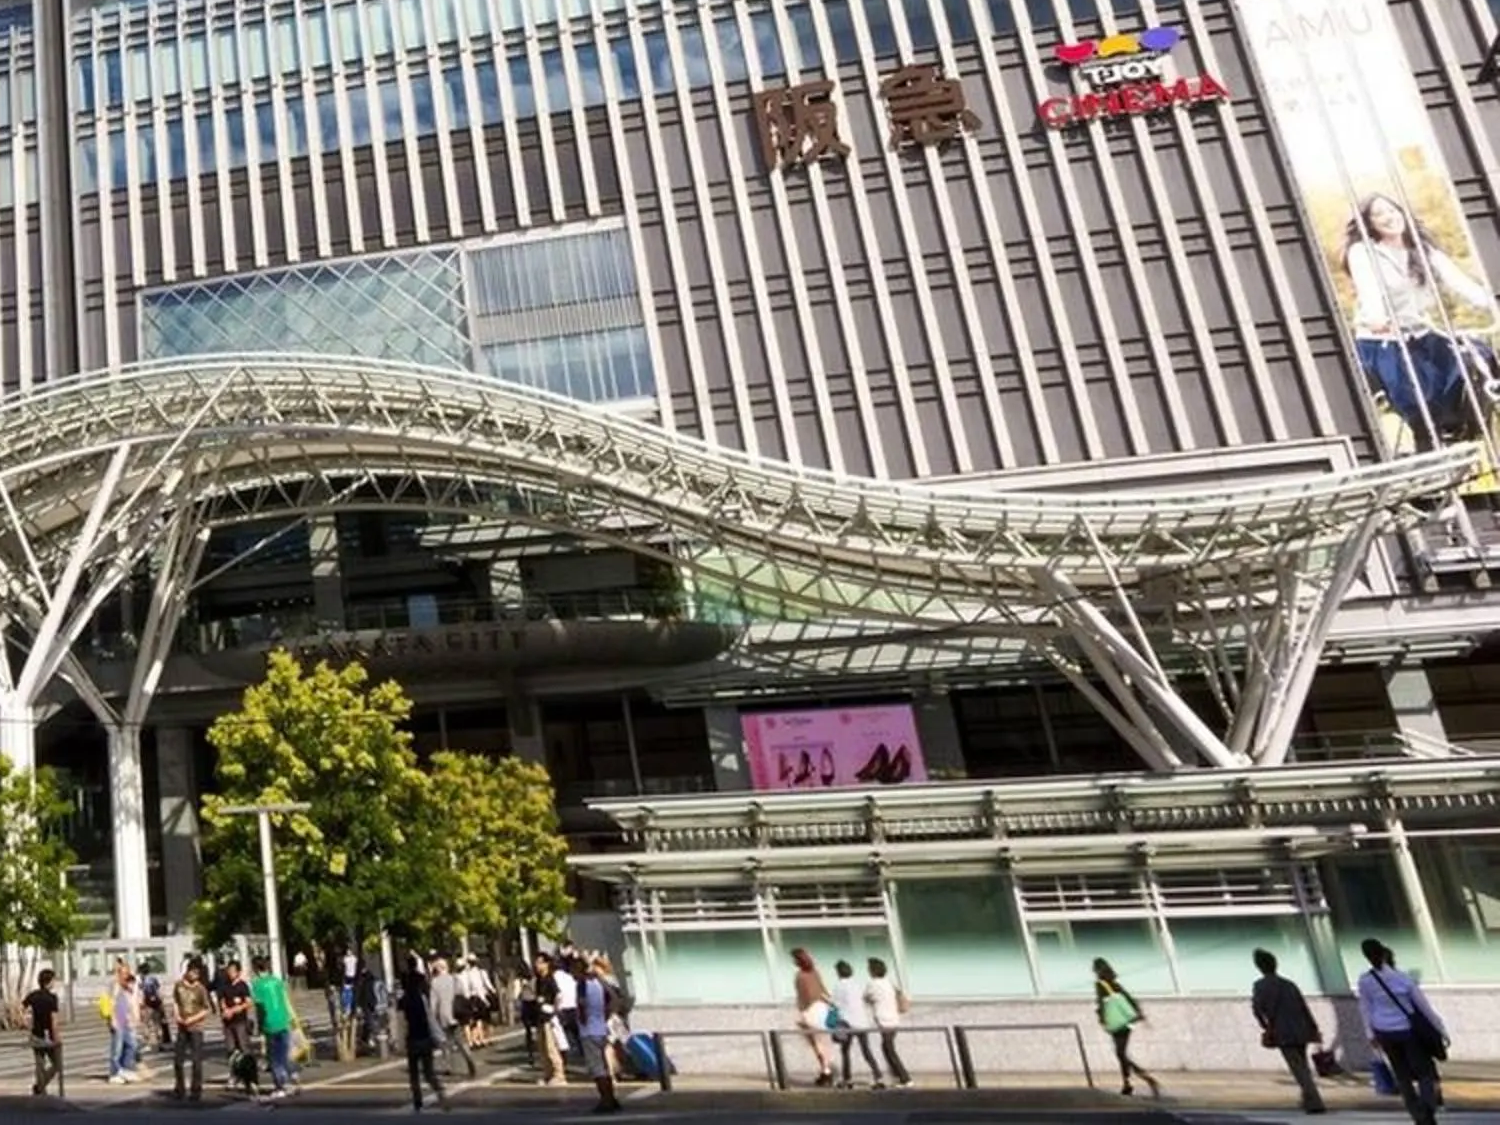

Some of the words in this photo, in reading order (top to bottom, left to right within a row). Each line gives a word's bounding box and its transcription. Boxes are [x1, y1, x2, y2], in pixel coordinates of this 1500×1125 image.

[1265, 2, 1374, 49] AMU
[753, 64, 984, 172] 阪急
[1039, 71, 1230, 129] CINEMA
